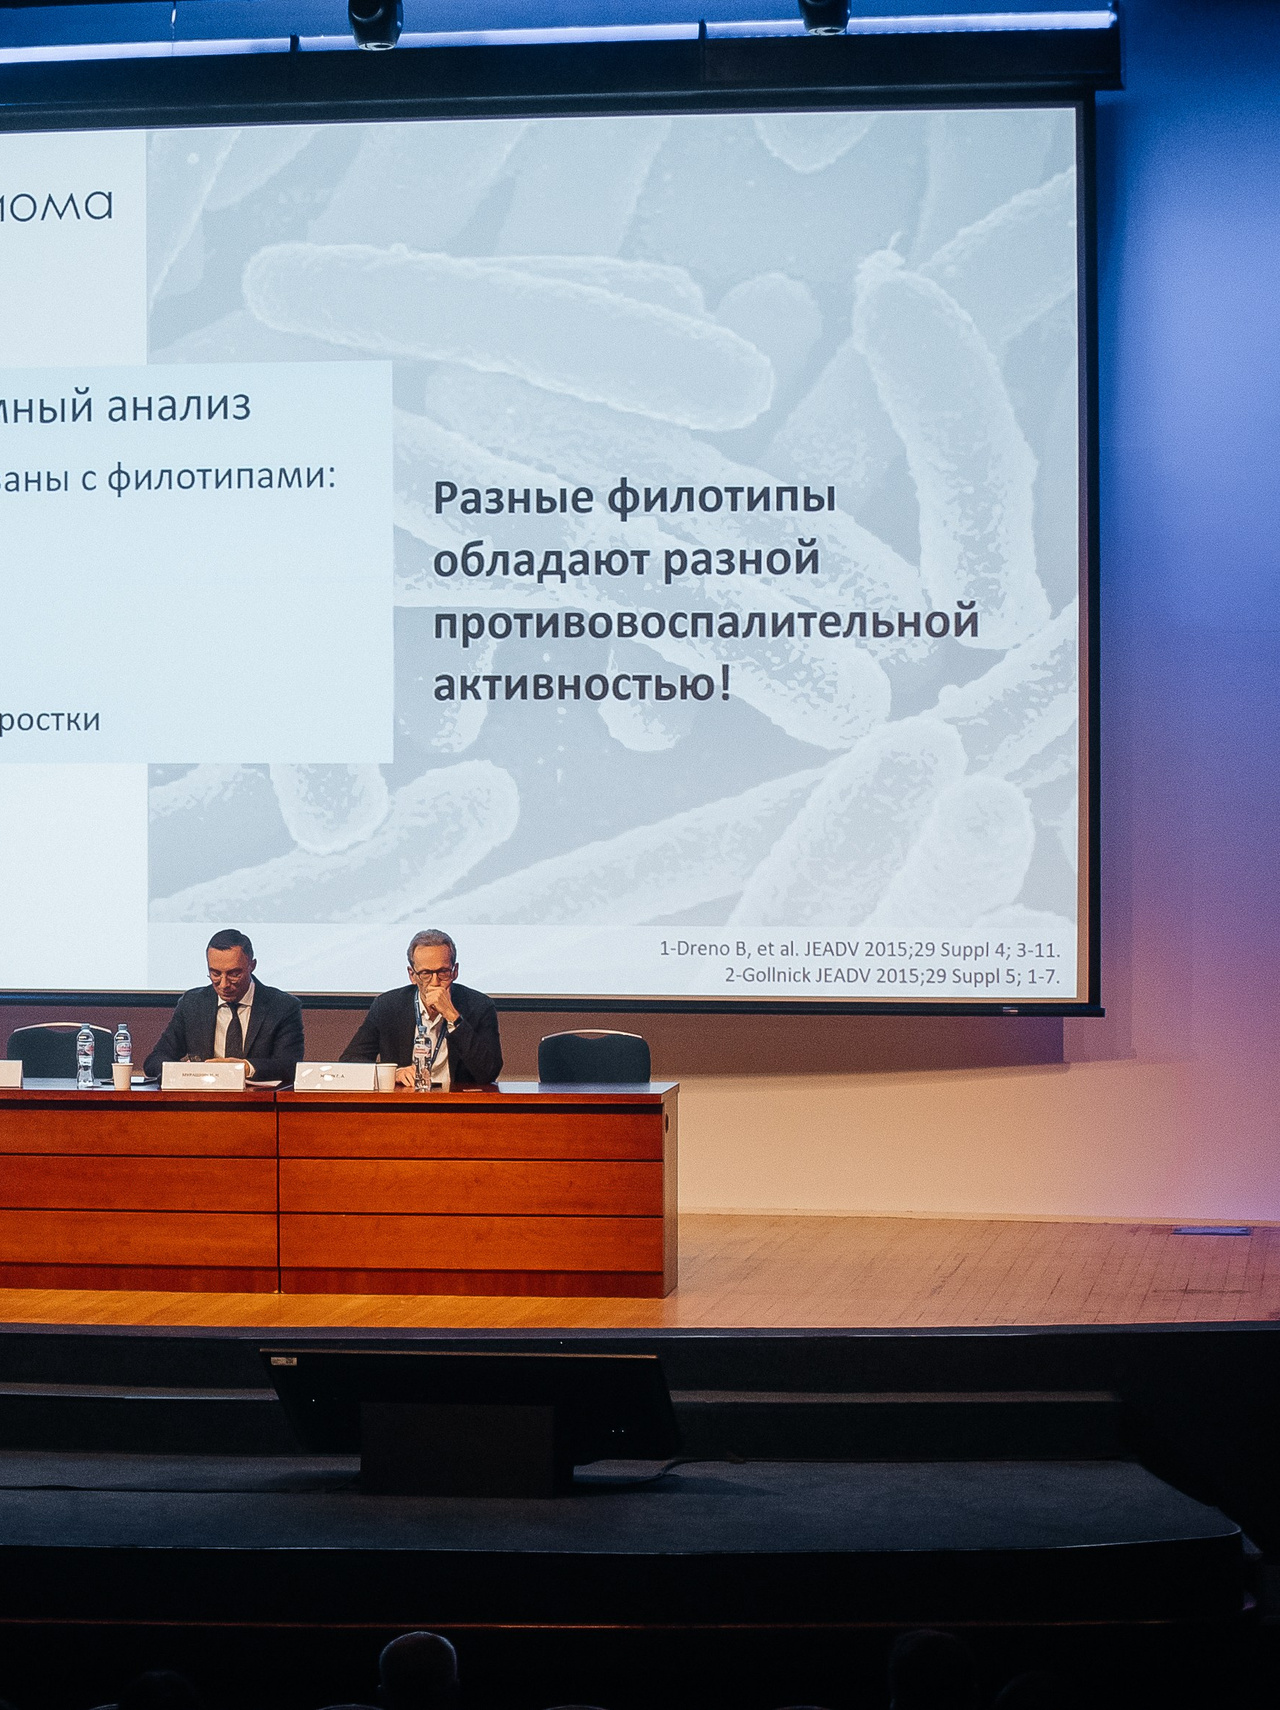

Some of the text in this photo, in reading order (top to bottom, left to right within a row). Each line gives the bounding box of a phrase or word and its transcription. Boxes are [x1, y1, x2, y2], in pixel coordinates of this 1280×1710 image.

[107, 393, 251, 423] анализ
[81, 469, 97, 492] с
[107, 461, 335, 498] филотипами:
[434, 476, 836, 523] Разные филотипы
[433, 537, 819, 585] обладают разной
[434, 600, 979, 649] противовоспалительной
[433, 663, 730, 702] активностью!
[660, 940, 1061, 962] 1-Dreno B, et al. JEADV 2015;29 Suppl 4; 3-11.
[725, 966, 1060, 988] 2-Gollnick JEADV 2015;29 Suppl 5; 1-7.
